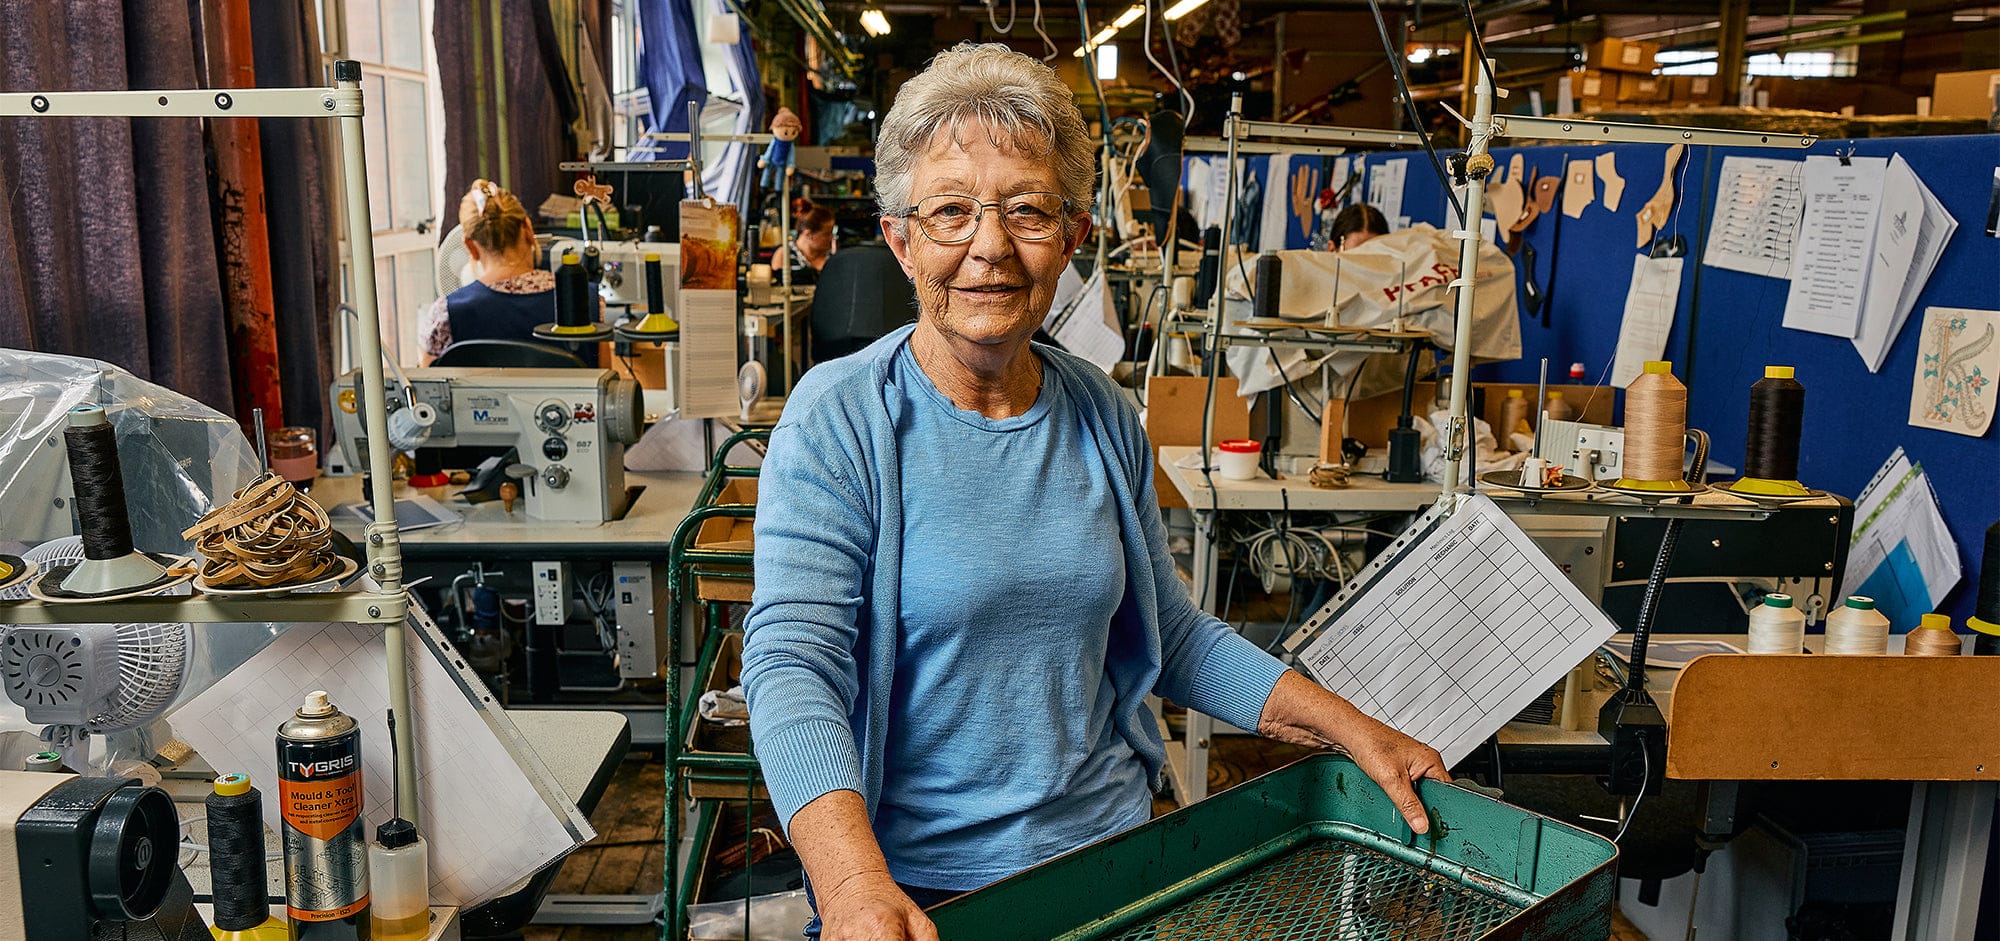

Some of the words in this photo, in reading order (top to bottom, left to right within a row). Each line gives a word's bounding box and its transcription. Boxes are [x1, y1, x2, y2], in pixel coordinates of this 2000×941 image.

[1467, 519, 1481, 532] DATE
[1433, 539, 1459, 562] MECHANIC
[1394, 576, 1417, 597] SOLUTION
[1351, 623, 1366, 636] ISSUE
[1318, 654, 1331, 666] DATE
[288, 754, 354, 778] TYGRIS
[290, 791, 323, 800] Mould
[325, 790, 334, 799] &
[335, 783, 355, 796] Tool
[293, 802, 333, 811] Cleaner
[334, 796, 354, 808] Xtra
